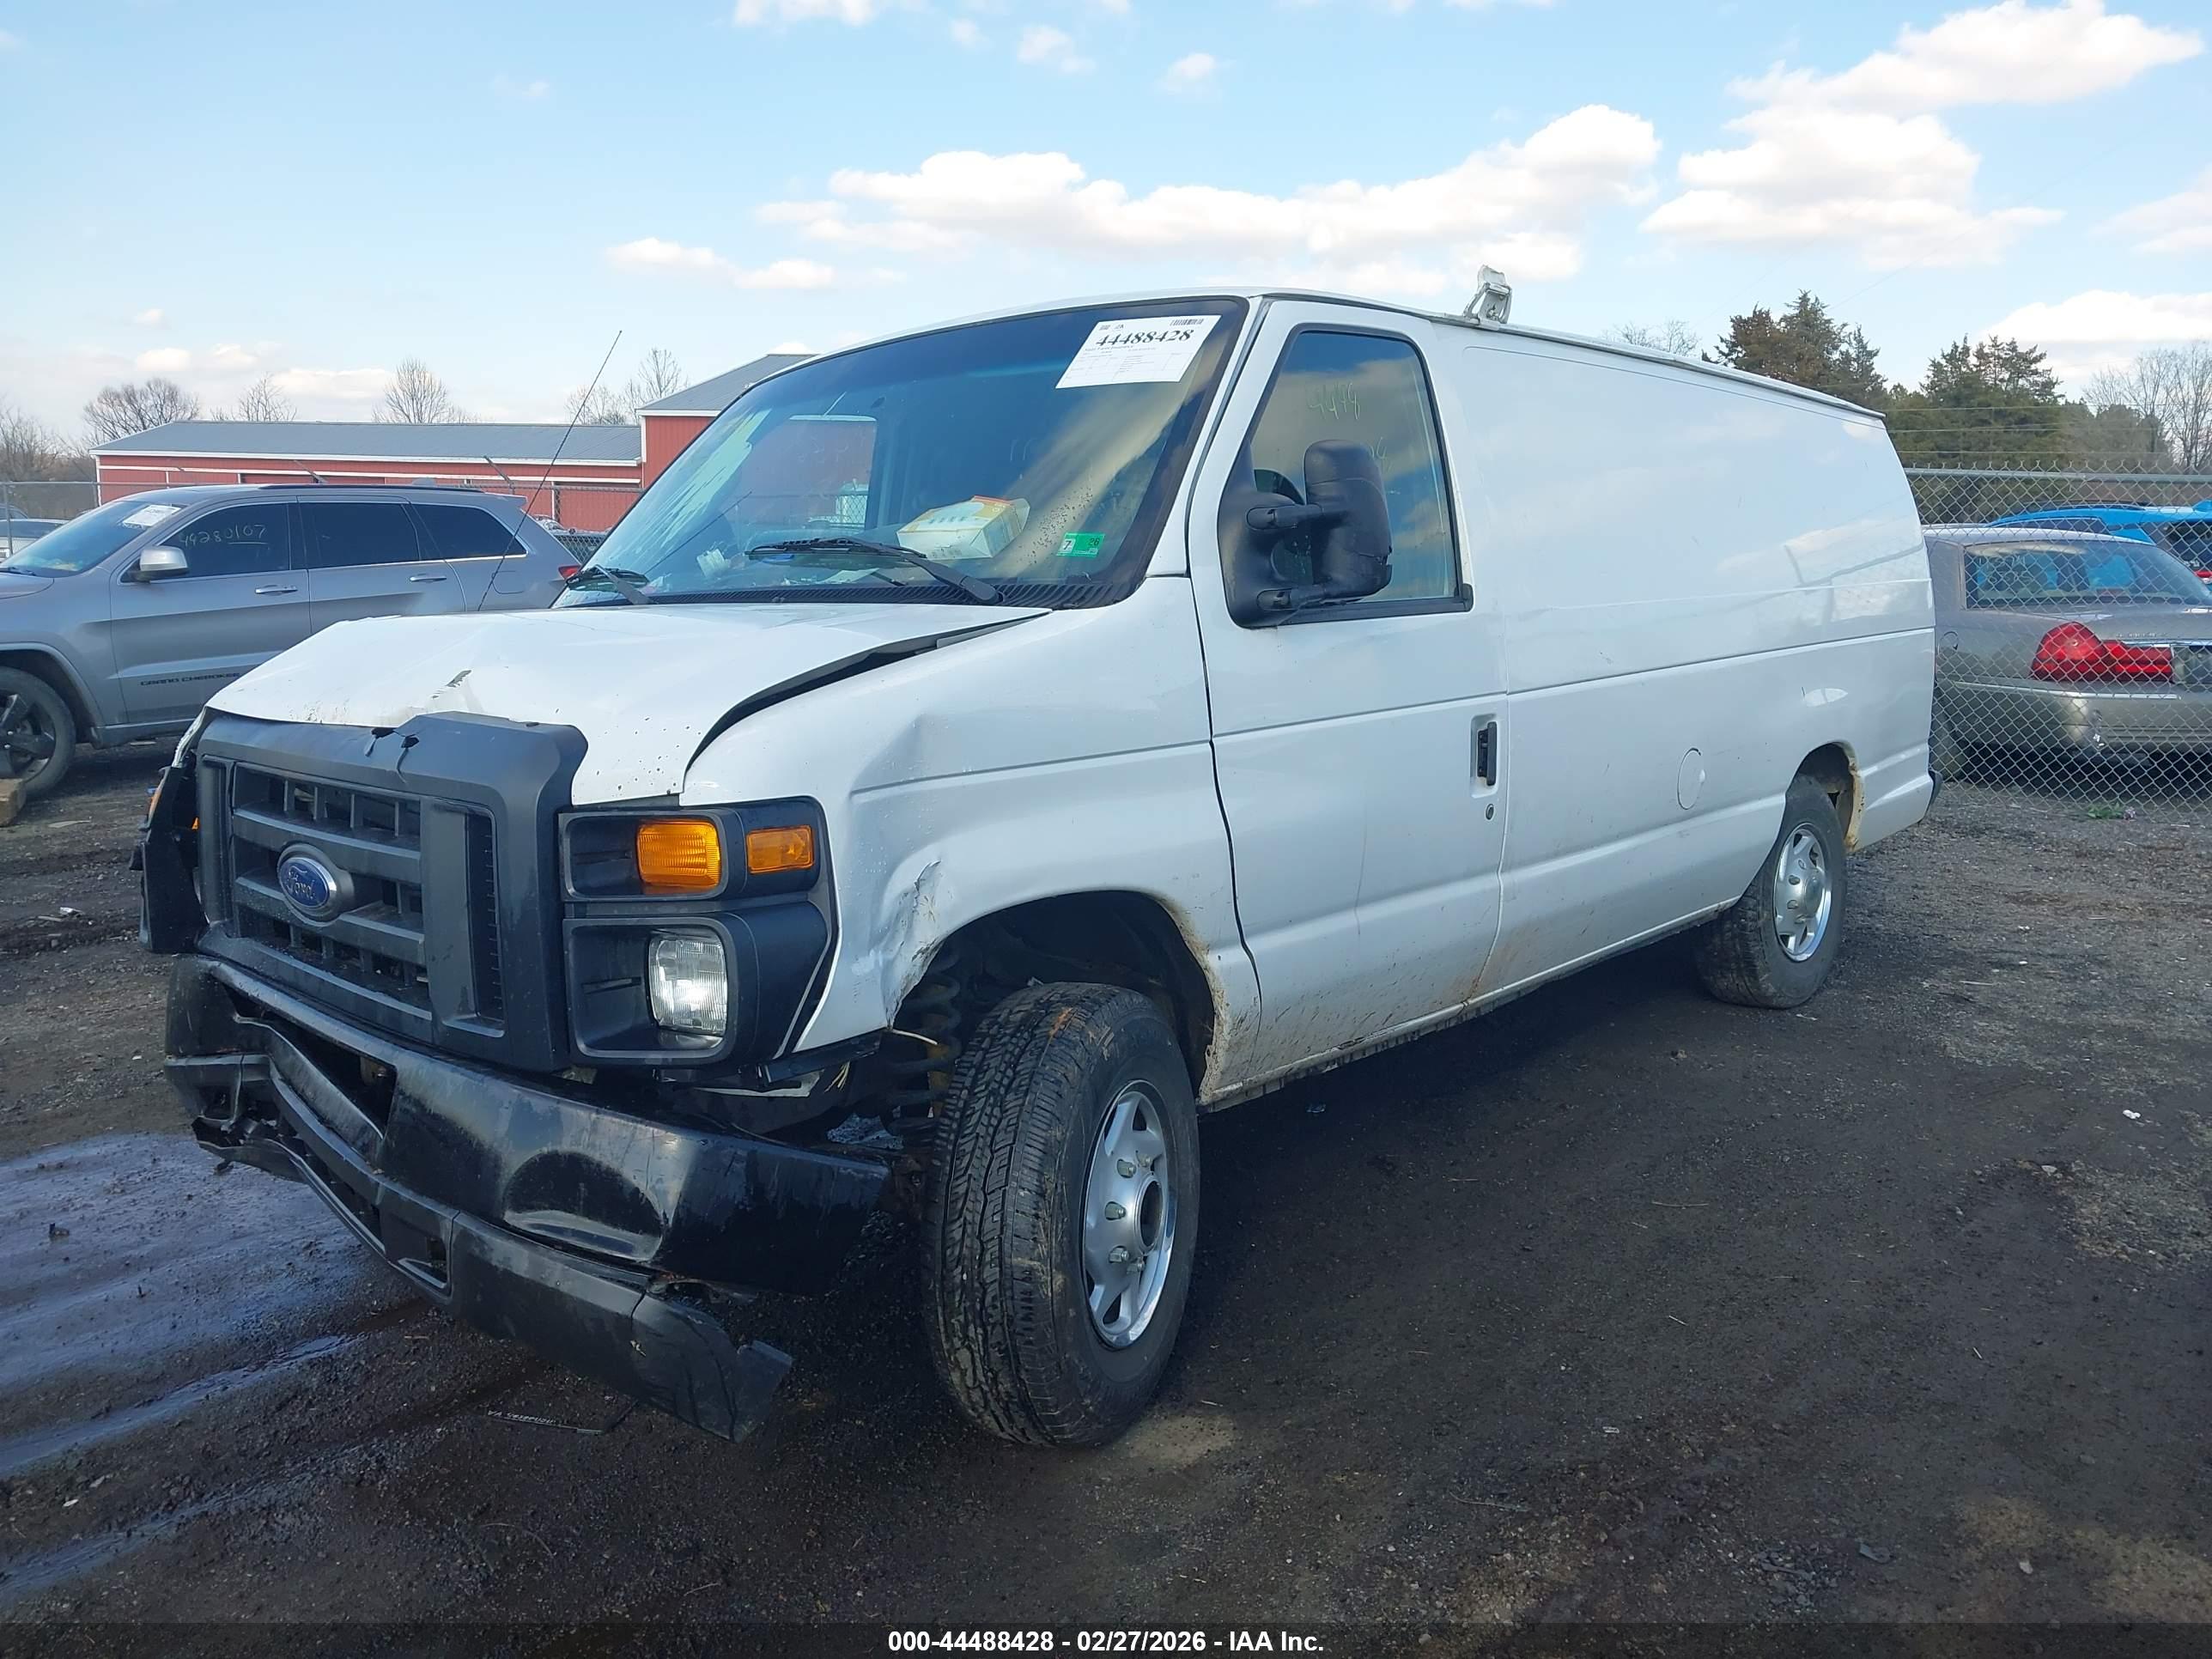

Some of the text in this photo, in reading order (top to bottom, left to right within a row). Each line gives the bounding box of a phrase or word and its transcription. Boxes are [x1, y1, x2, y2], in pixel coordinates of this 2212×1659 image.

[1096, 330, 1194, 346] 44488428
[1064, 540, 1073, 550] 7
[140, 678, 179, 686] GRAND
